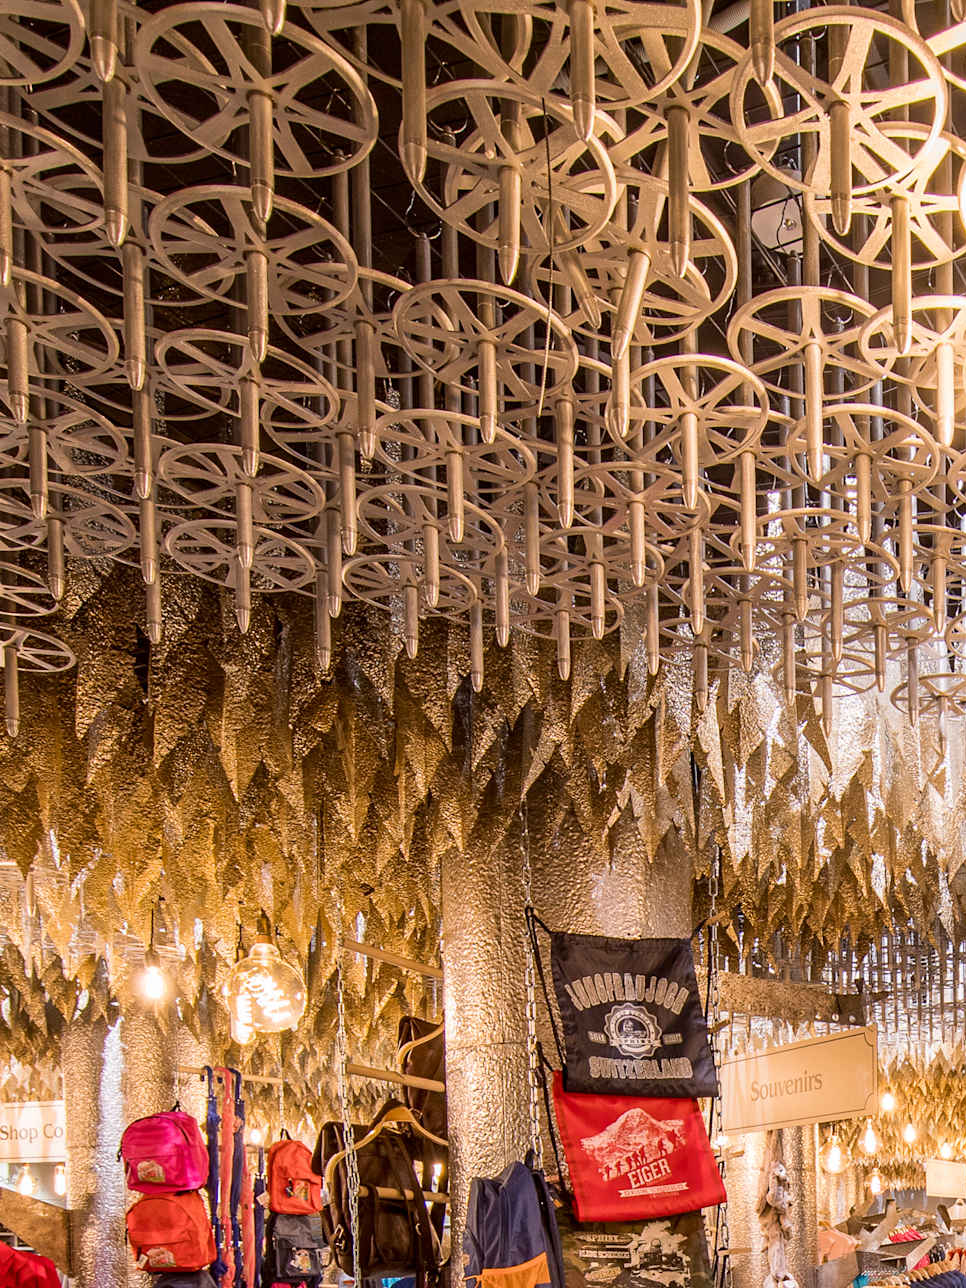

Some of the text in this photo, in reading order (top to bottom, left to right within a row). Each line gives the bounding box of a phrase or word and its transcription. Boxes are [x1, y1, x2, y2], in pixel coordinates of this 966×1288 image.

[588, 1055, 694, 1079] SWITZERLAND
[751, 1069, 823, 1102] Souvenirs
[0, 1124, 38, 1144] Shop
[627, 1158, 671, 1189] EIGER
